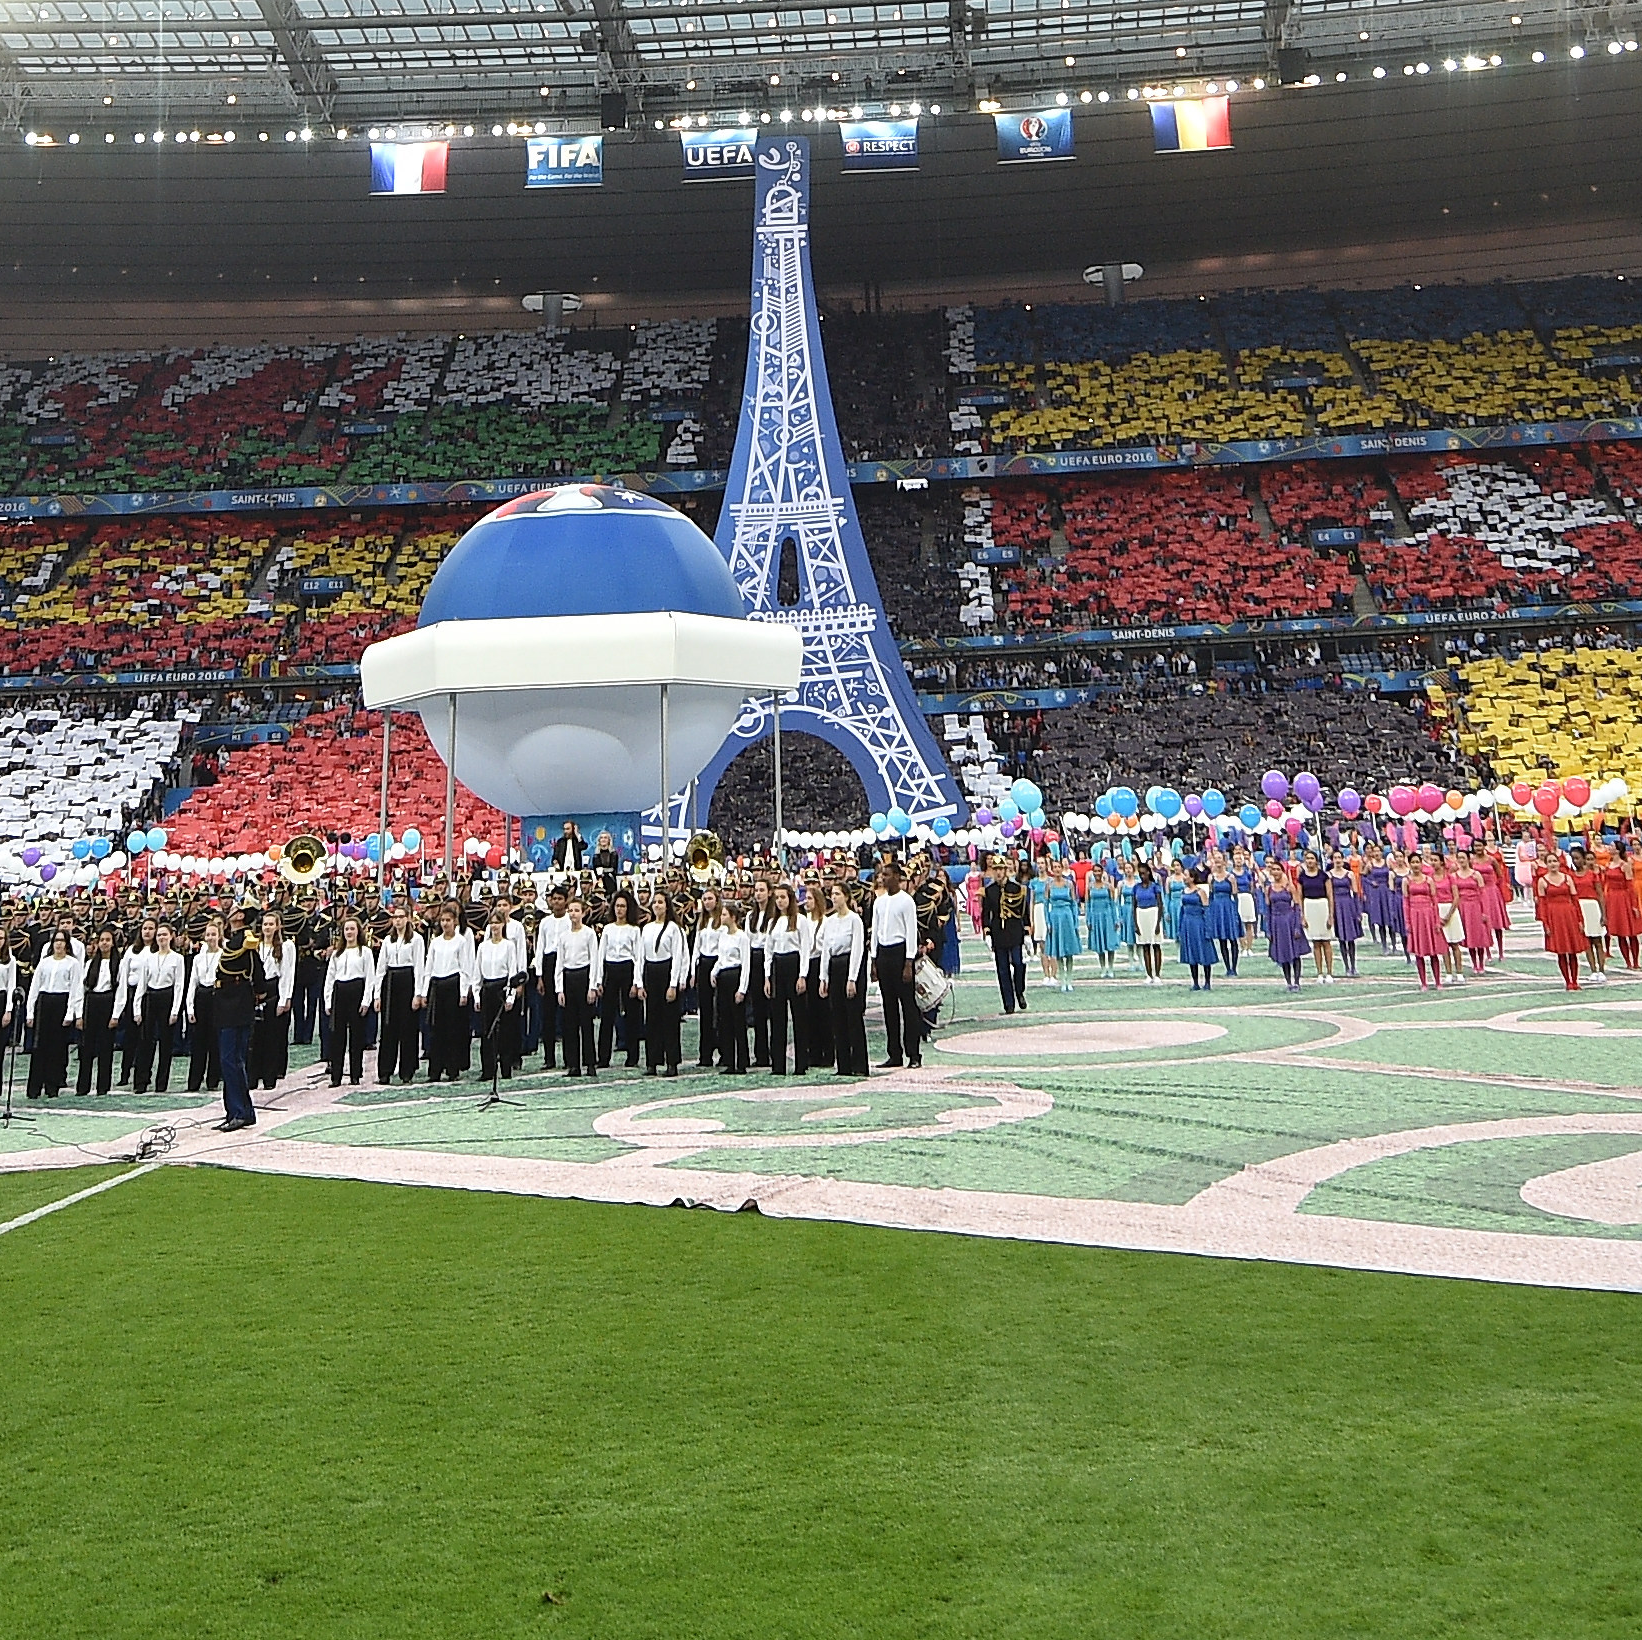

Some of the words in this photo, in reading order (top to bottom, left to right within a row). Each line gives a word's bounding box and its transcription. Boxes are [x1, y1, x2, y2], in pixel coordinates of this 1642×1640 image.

[863, 140, 914, 153] RESPECT
[528, 144, 600, 169] FIFA
[686, 145, 753, 166] UEFA
[1360, 436, 1427, 449] SAINDENIS
[1060, 456, 1091, 466] UEFA
[1092, 454, 1123, 465] EURO
[1125, 452, 1153, 463] 2016
[498, 483, 529, 494] UEFA
[231, 493, 296, 506] SAINT-NIS
[303, 581, 320, 590] E12
[328, 580, 344, 589] E11
[1425, 613, 1457, 624] UEFA
[1458, 610, 1489, 622] EURO
[1490, 608, 1520, 620] 2016
[1111, 628, 1175, 641] SAINT-DENIS
[134, 672, 163, 683] UEFA
[165, 672, 196, 683] EURO
[198, 670, 226, 681] 2016
